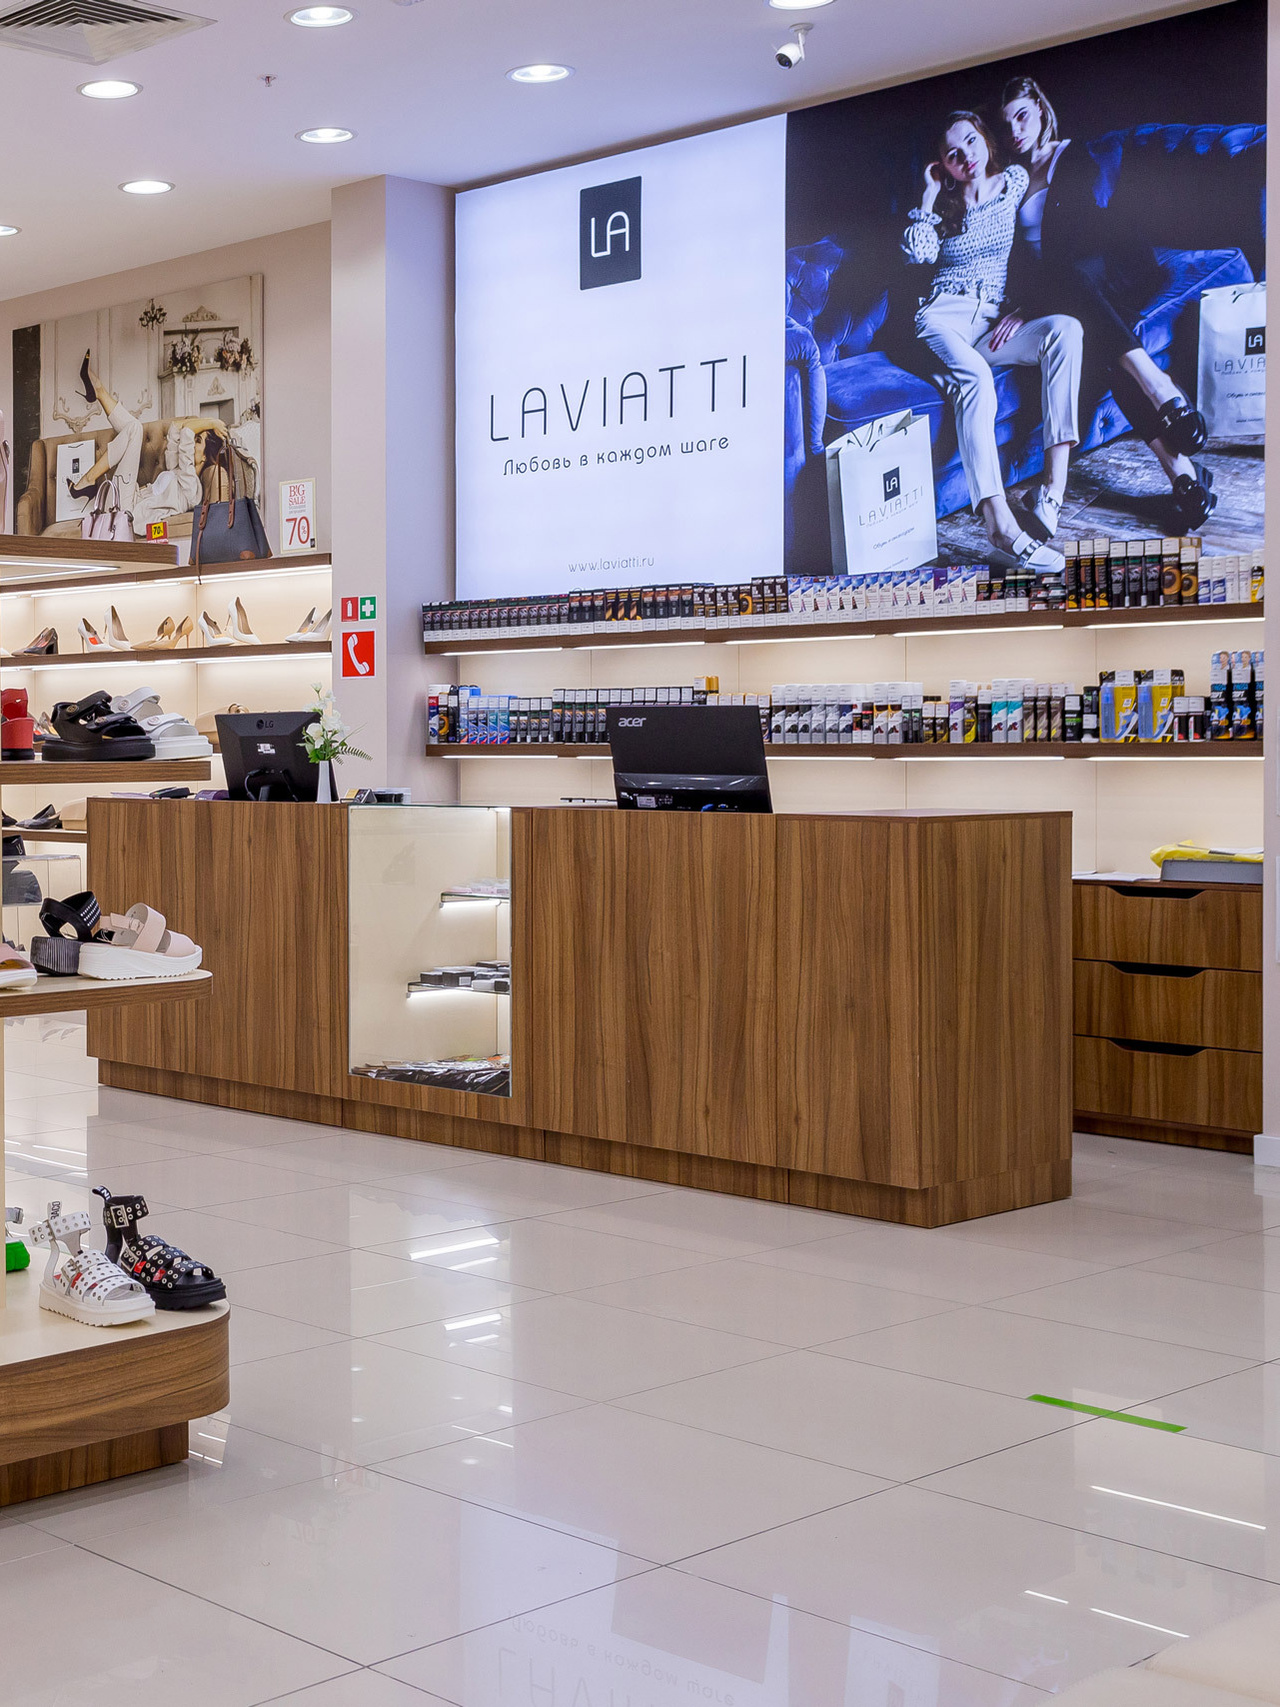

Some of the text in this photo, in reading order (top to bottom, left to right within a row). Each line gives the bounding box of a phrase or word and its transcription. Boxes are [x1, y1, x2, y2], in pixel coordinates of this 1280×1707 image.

[590, 210, 630, 258] LA
[489, 354, 748, 443] LAVIATTI
[502, 435, 730, 476] Любовь в каждом шаге
[858, 485, 924, 527] LAVIATTI
[568, 556, 655, 573] www.laviatti.ru
[618, 716, 646, 727] acer
